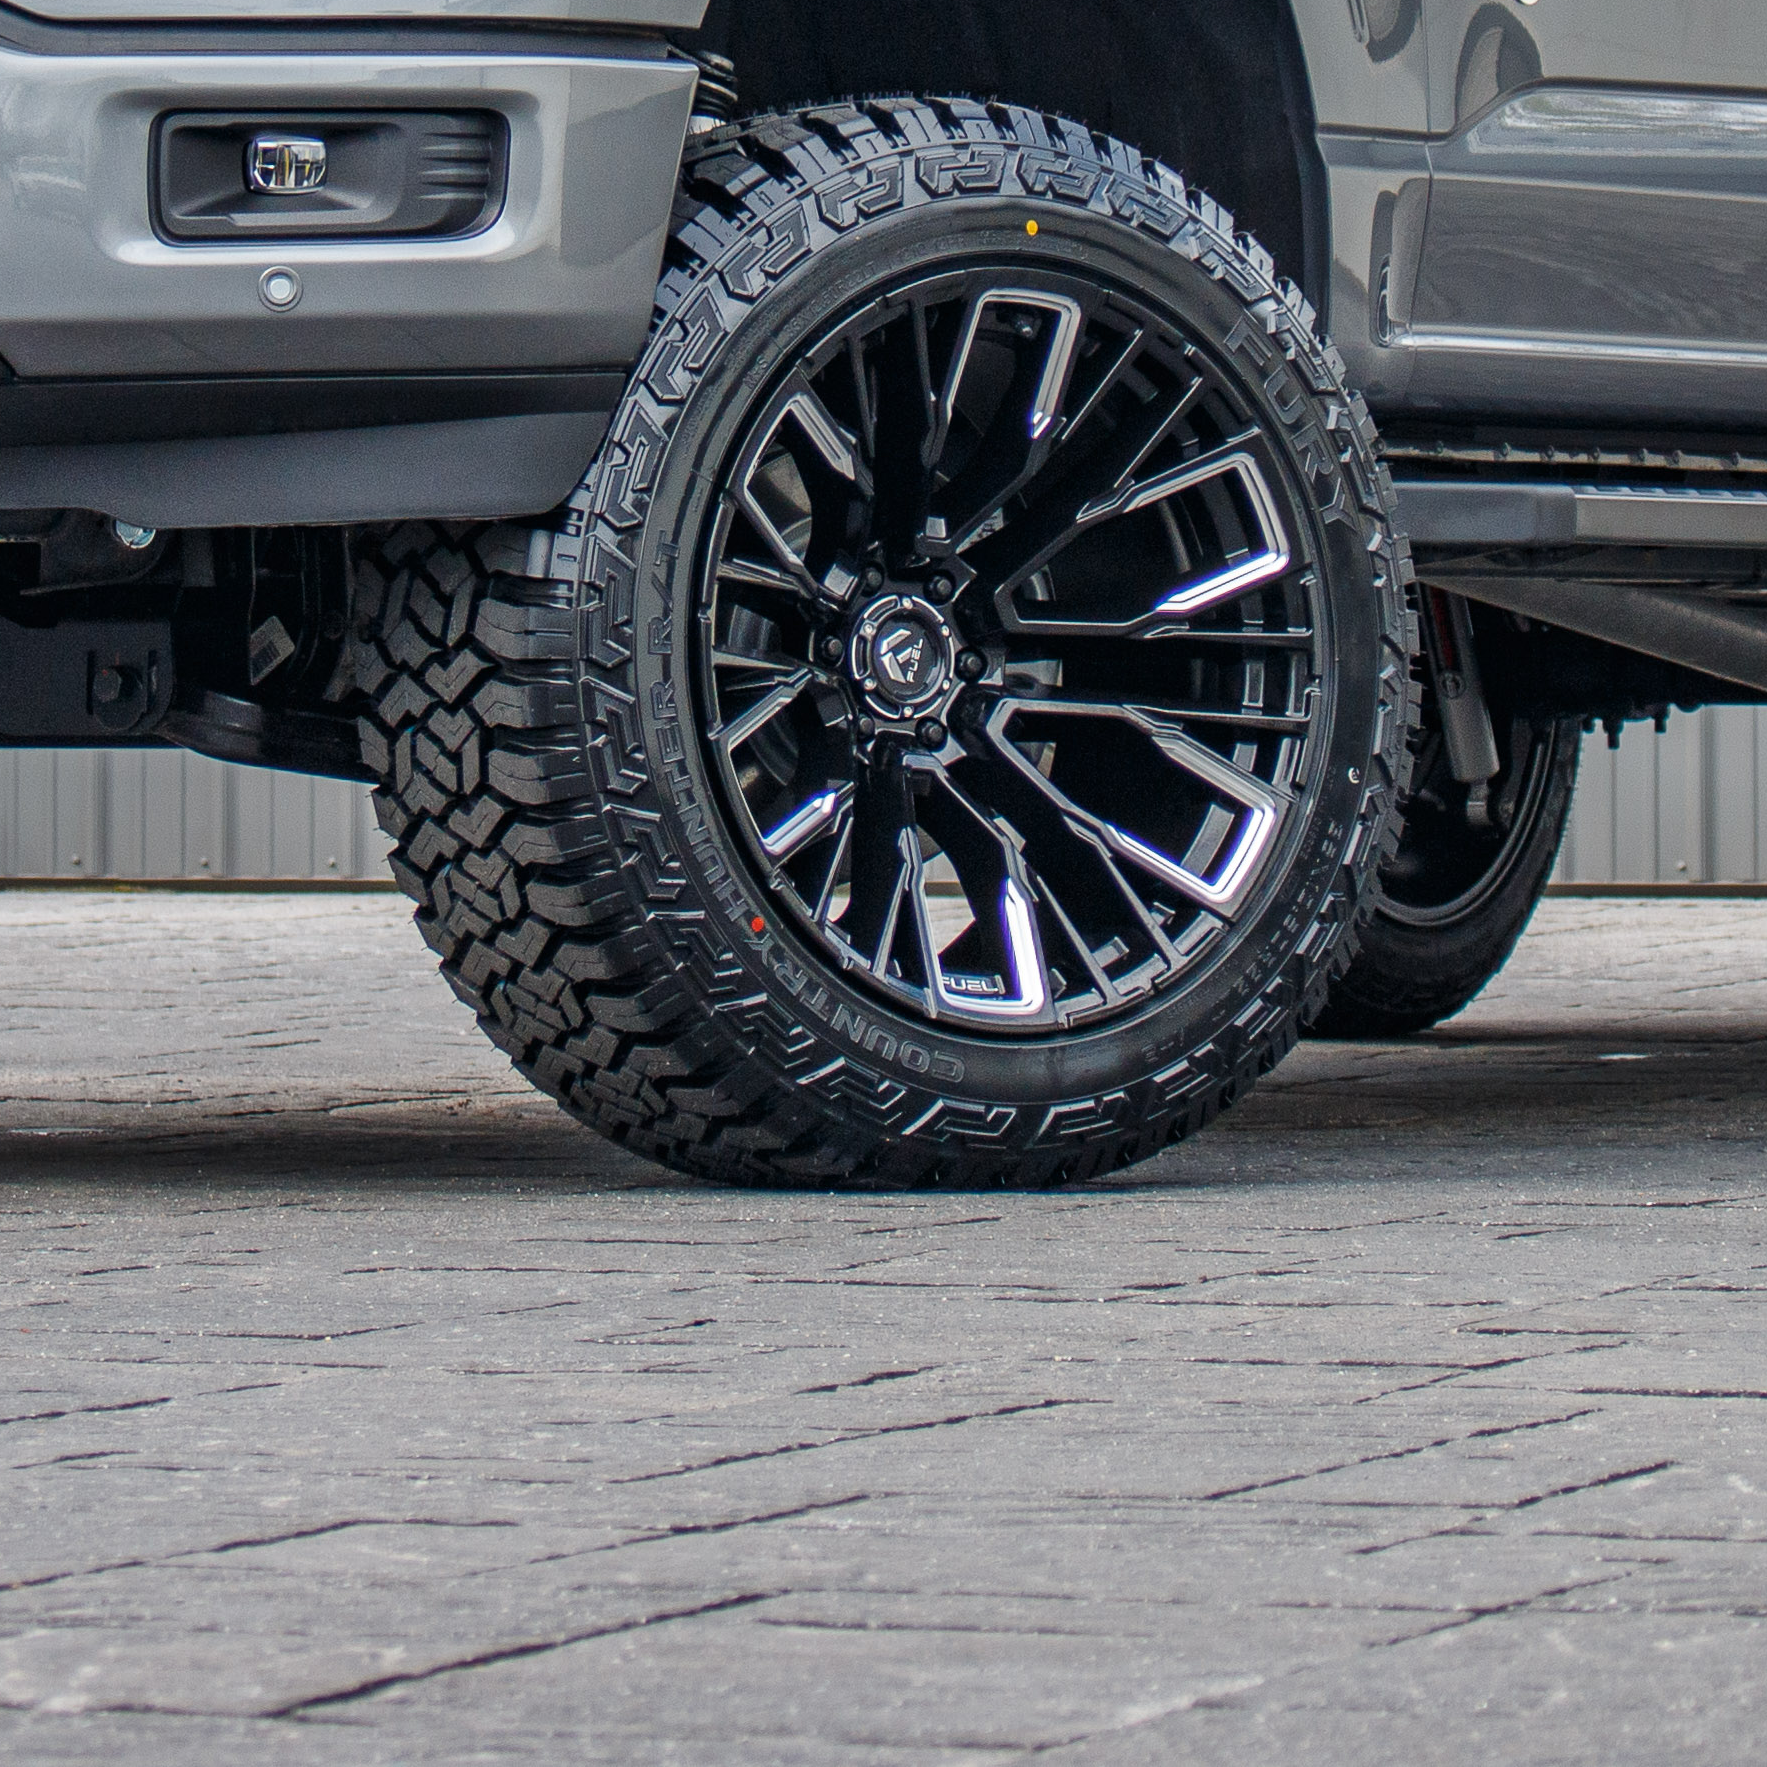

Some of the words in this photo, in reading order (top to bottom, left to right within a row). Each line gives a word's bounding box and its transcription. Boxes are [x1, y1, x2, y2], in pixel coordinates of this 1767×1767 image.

[1223, 307, 1358, 532] FURY
[906, 638, 924, 683] FUEL
[649, 680, 751, 922] HUNTER
[743, 933, 966, 1084] COUNTRY
[941, 976, 999, 992] FUEL
